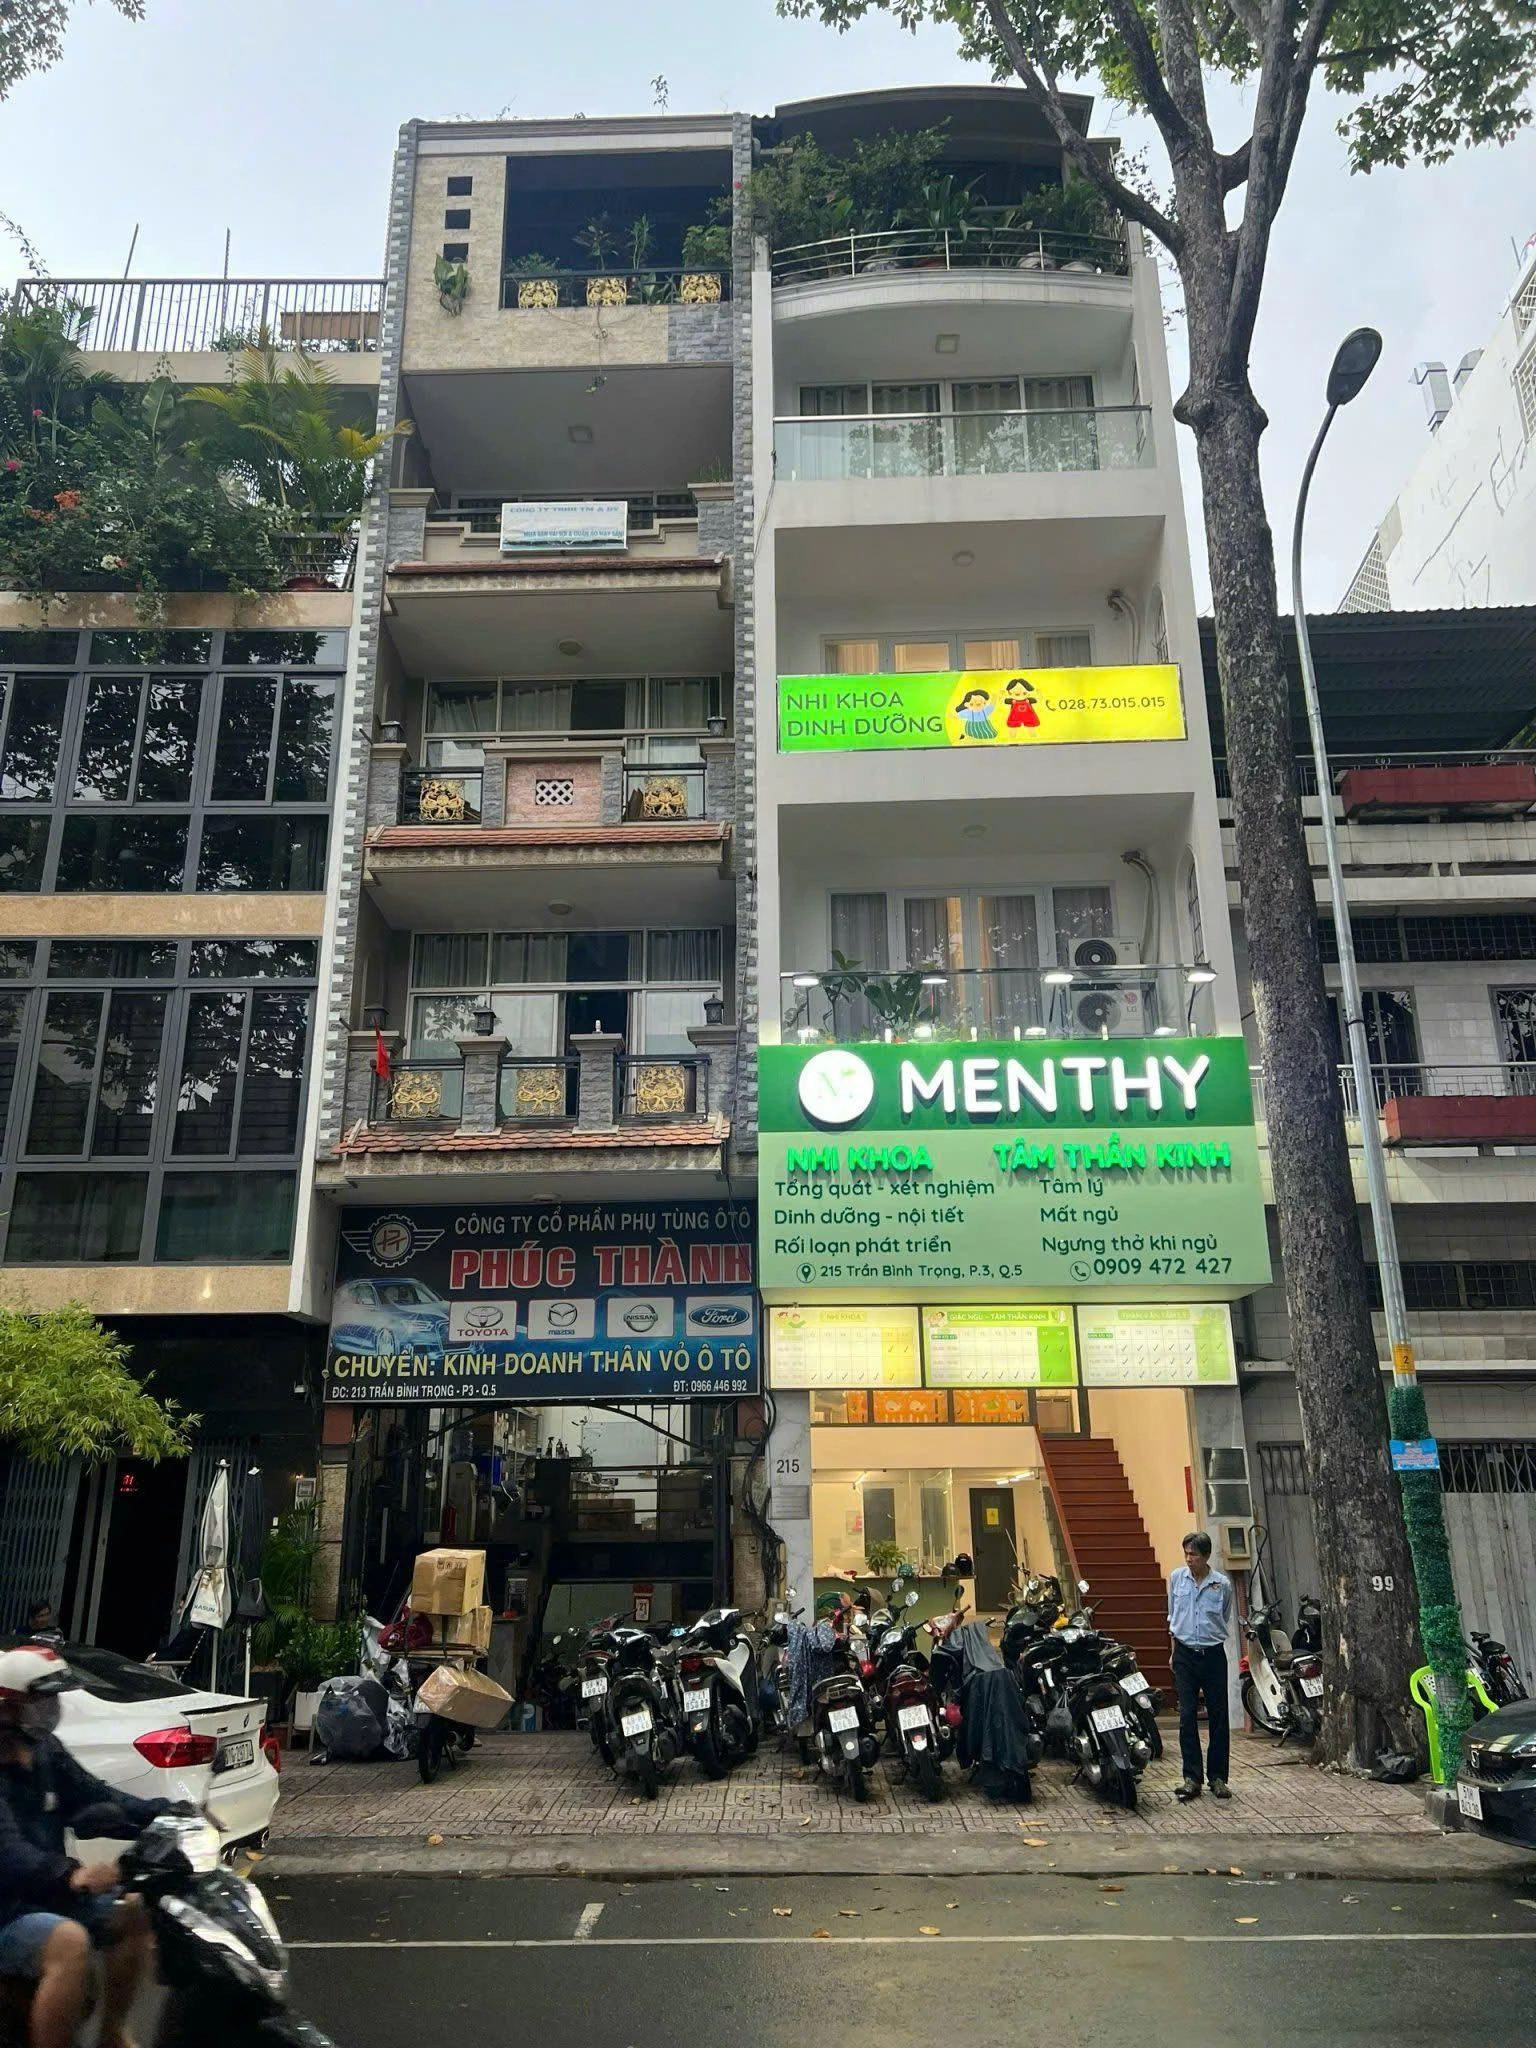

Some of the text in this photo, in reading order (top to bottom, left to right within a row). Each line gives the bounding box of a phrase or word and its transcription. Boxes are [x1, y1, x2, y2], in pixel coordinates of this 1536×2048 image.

[787, 691, 904, 710] NHI KHOA
[1059, 696, 1165, 710] 028.73.015.015
[788, 713, 943, 737] DINH DƯỠNG
[901, 1054, 1210, 1114] MENTHY
[787, 1144, 935, 1172] NHI KHOA
[993, 1132, 1232, 1171] TÂM THẦN KINH
[775, 1179, 823, 1199] Tổng
[828, 1181, 872, 1199] quát
[890, 1181, 920, 1195] xét
[925, 1180, 995, 1198] nghiệm
[1039, 1178, 1104, 1197] Tâm lý
[455, 1212, 505, 1235] CÔNG
[511, 1215, 533, 1233] TY
[538, 1205, 563, 1233] CỔ
[568, 1206, 615, 1232] PHẦN
[621, 1212, 656, 1234] PHỤ
[662, 1208, 709, 1230] TÙNG
[774, 1209, 815, 1225] Dinh
[821, 1206, 880, 1227] dưỡng
[898, 1210, 926, 1226] nội
[931, 1205, 965, 1223] tiết
[1040, 1204, 1119, 1225] Mất ngủ
[775, 1235, 952, 1256] Rối loạn phát triển
[1042, 1234, 1217, 1255] Ngưng thở khi ngủ
[450, 1237, 752, 1290] PHÚC THÀNH
[820, 1263, 1023, 1279] 215 Trần Bình Trọng, P.3, Q.5
[1093, 1257, 1232, 1276] 0909 472 427
[701, 1308, 738, 1324] Ford
[457, 1328, 509, 1337] TOYOTA
[334, 1350, 435, 1377] CHUYÊN:
[443, 1353, 496, 1376] KINH
[504, 1351, 583, 1375] DOANH
[590, 1345, 651, 1372] THÂN
[659, 1341, 690, 1372] VỎ
[697, 1343, 714, 1371] Ô
[720, 1343, 751, 1371] TÔ
[332, 1386, 349, 1399] ĐC:
[351, 1386, 366, 1398] 213
[369, 1381, 394, 1398] TRẦN
[397, 1382, 419, 1397] BÌNH
[421, 1384, 454, 1399] TRỌNG
[462, 1385, 474, 1396] P3
[481, 1384, 497, 1397] Q.5
[673, 1379, 747, 1392] ĐT: 0966 446 992
[776, 1458, 800, 1474] 215
[1372, 1575, 1394, 1592] 99
